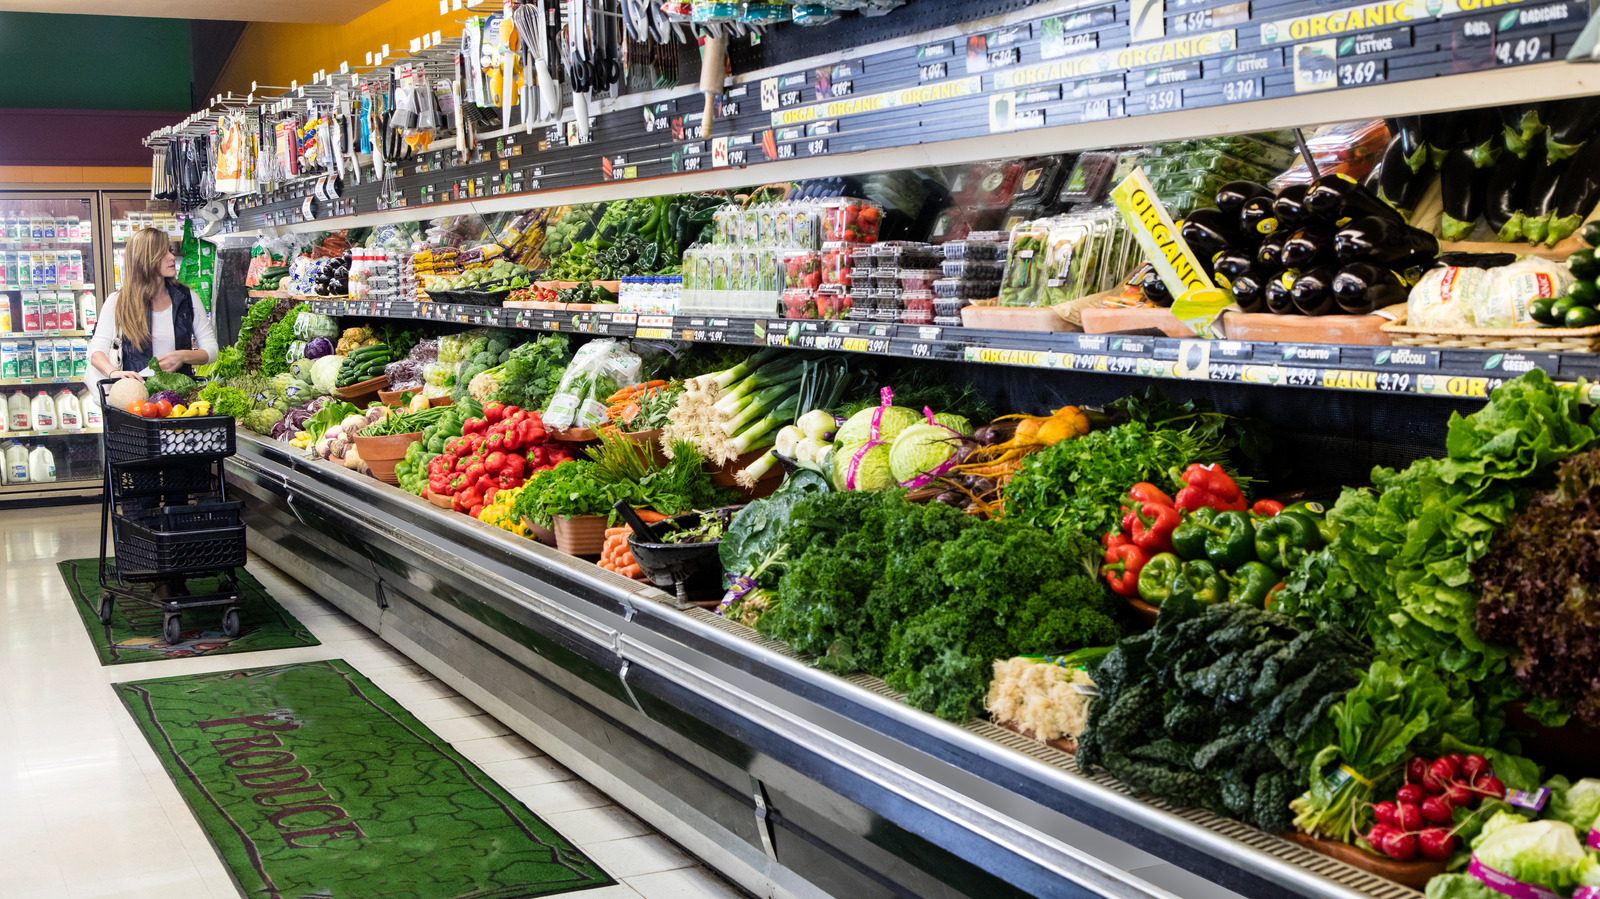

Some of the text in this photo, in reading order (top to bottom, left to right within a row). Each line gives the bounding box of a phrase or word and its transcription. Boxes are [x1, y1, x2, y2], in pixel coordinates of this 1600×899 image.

[1289, 1, 1414, 39] ORGANIC
[1519, 4, 1569, 25] RADISHES
[1118, 36, 1213, 69] ORGANIC
[1355, 38, 1393, 55] LETTUCE
[1496, 37, 1541, 64] $4.49
[1013, 58, 1092, 86] ORGANIC
[1236, 57, 1268, 73] LETTUCE
[1339, 61, 1376, 85] $3.69
[1159, 69, 1188, 85] LETTUCE
[902, 81, 966, 104] ORGANIC
[1223, 79, 1254, 101] $3.79
[783, 95, 883, 124] ORGA ORGANIC
[1146, 90, 1174, 111] $3.59
[980, 348, 1043, 367] ORGANIC
[1296, 348, 1330, 360] CILANTRO
[1390, 352, 1426, 365] BROCCOLI
[1108, 356, 1132, 373] $2.99
[1209, 362, 1236, 380] $2.99
[1502, 359, 1536, 372] GREENS
[1287, 367, 1317, 385] $2.99
[1377, 372, 1410, 392] $3.79
[1446, 377, 1487, 397] OR
[197, 713, 366, 849] PRODUCE
